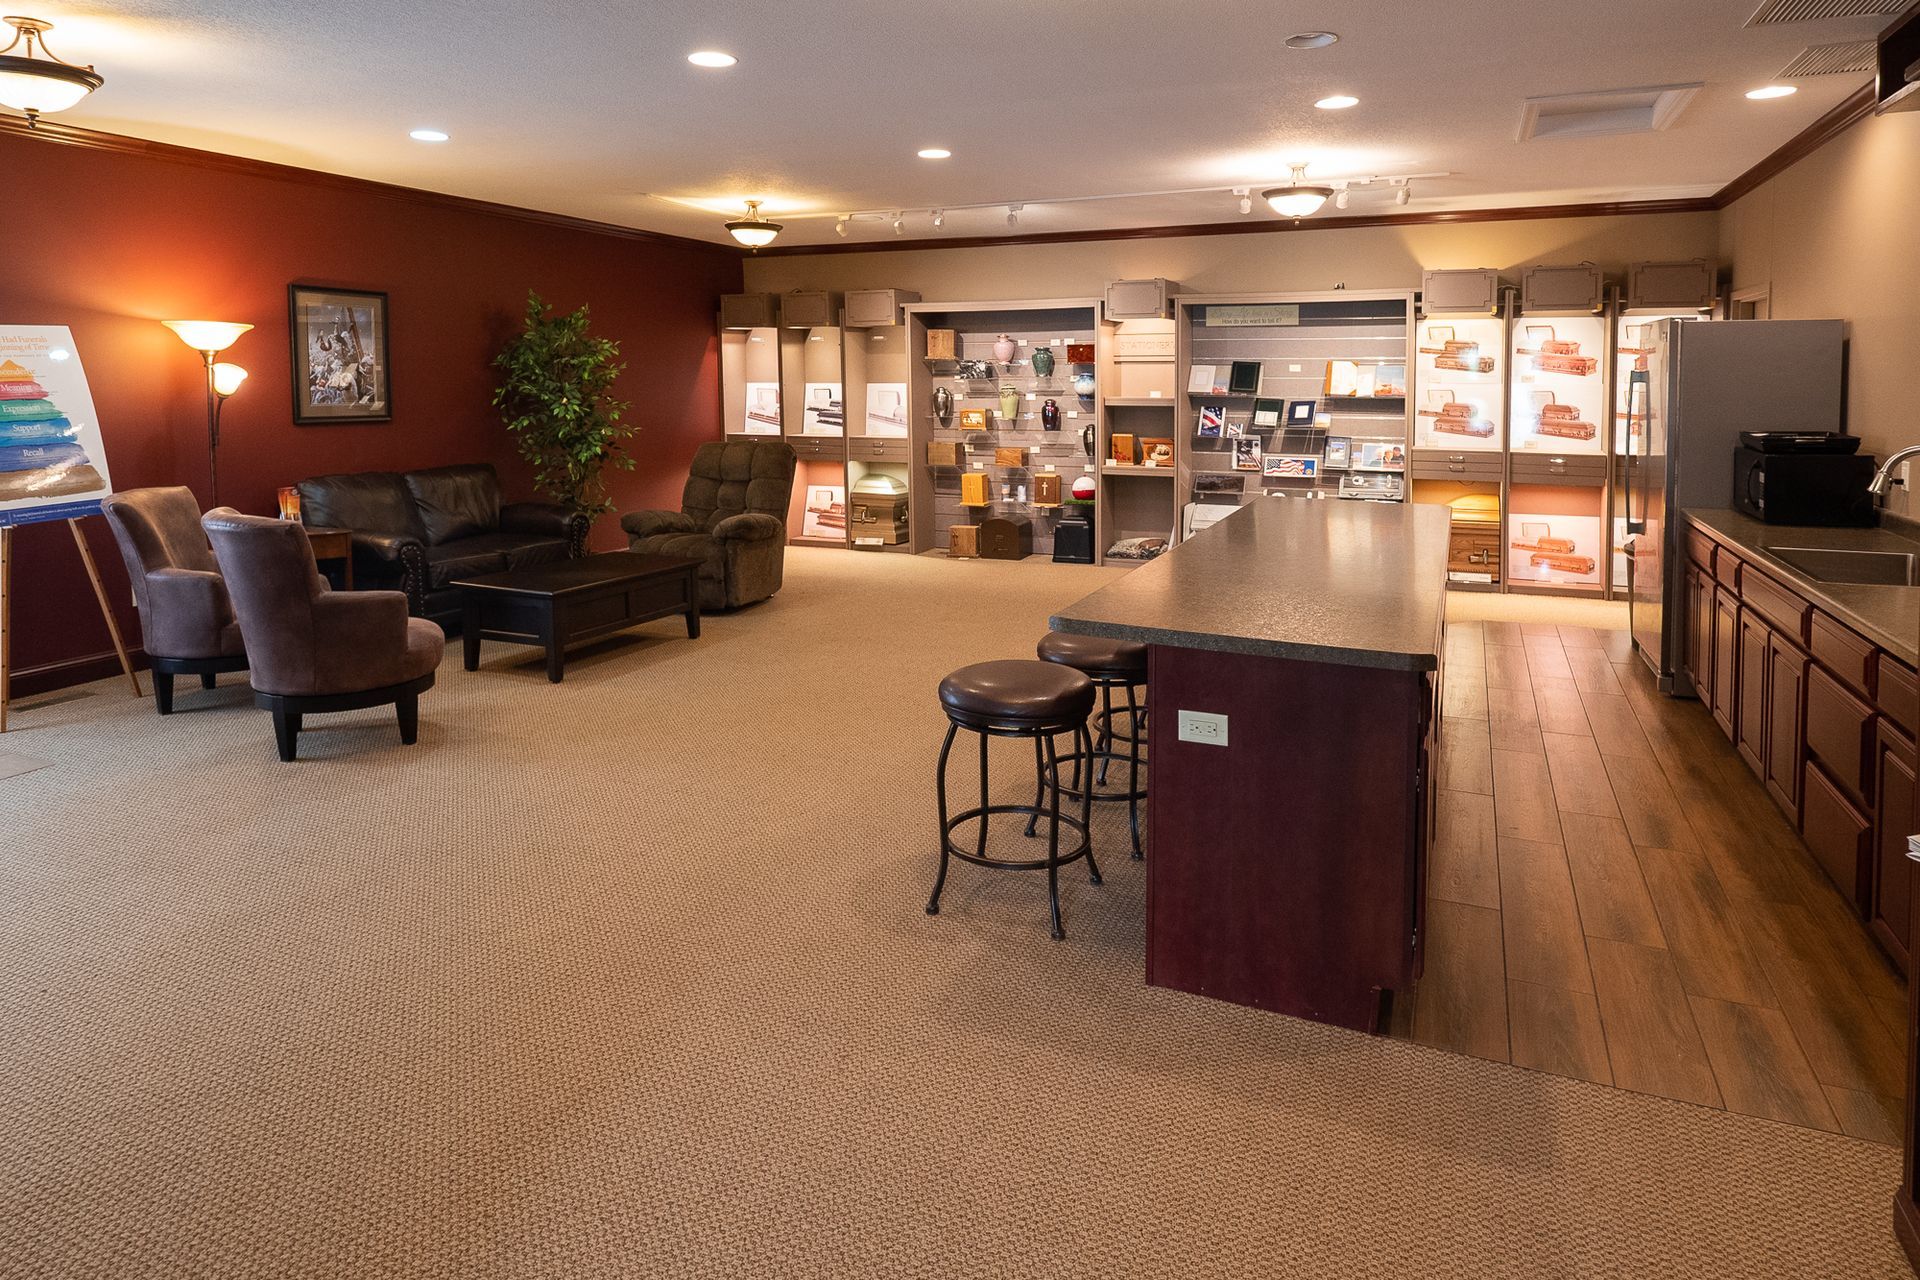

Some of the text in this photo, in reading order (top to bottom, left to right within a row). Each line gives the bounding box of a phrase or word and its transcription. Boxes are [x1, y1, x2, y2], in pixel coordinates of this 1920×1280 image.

[25, 343, 31, 351] of
[1, 384, 32, 393] Meaning
[2, 405, 41, 415] Expression
[12, 424, 41, 433] Support
[23, 448, 44, 457] Recall
